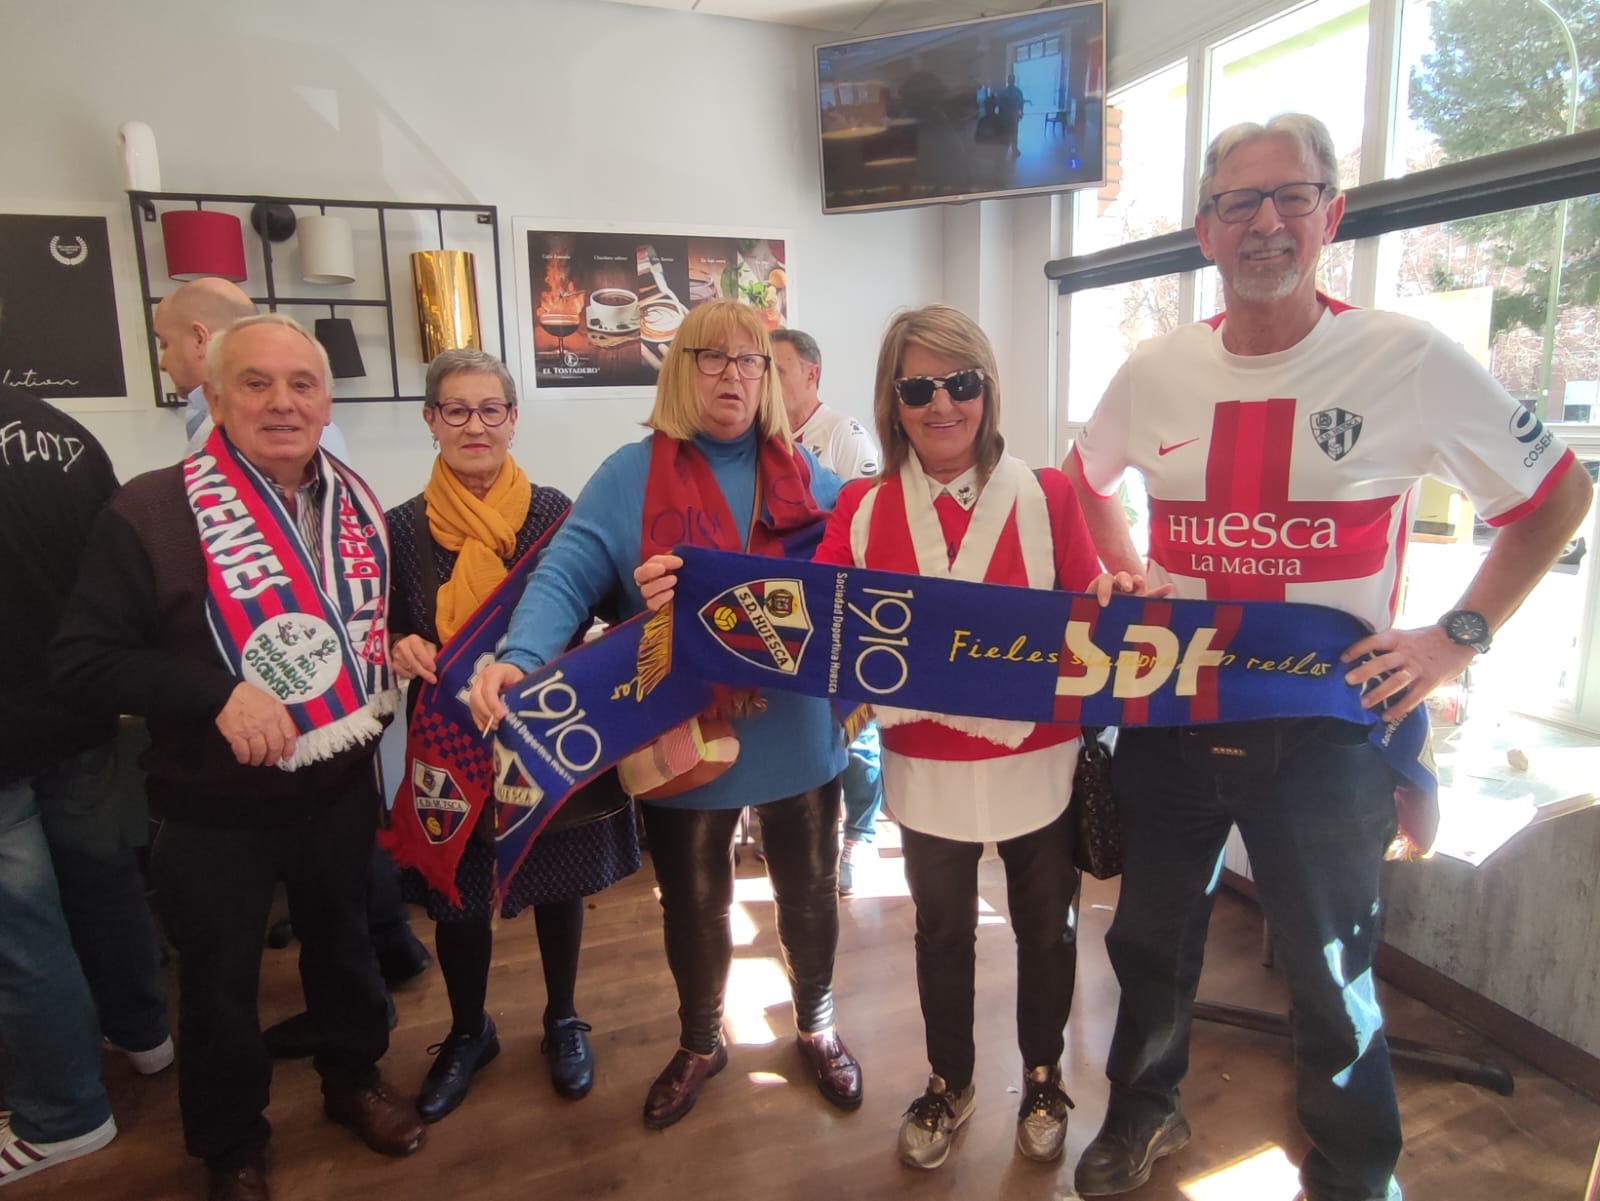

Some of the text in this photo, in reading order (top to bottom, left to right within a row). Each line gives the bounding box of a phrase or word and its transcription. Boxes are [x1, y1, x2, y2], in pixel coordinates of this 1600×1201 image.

[0, 420, 85, 472] FLOYD
[1523, 430, 1554, 468] COSEH
[833, 572, 848, 615] Sociedad
[829, 616, 845, 660] Deportiva
[847, 588, 914, 694] 1910
[949, 630, 1059, 663] Fieles
[517, 669, 602, 771] 1910
